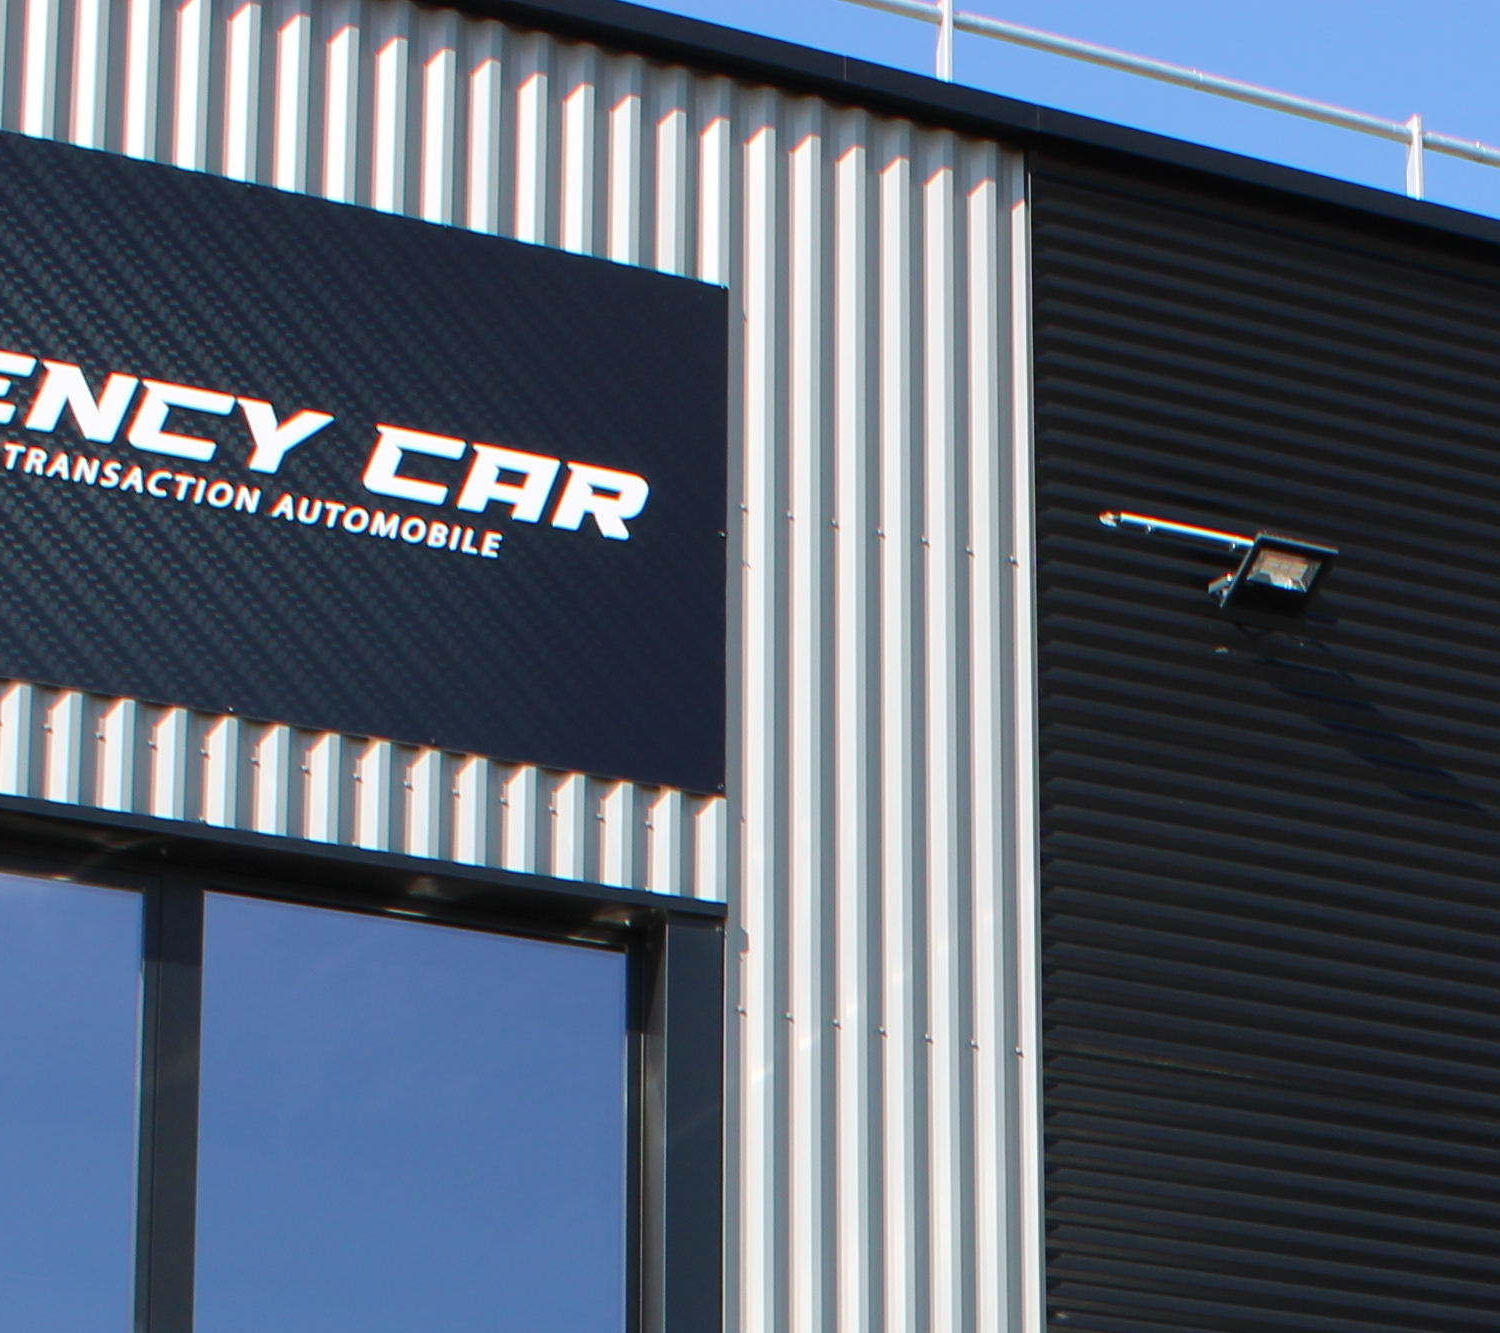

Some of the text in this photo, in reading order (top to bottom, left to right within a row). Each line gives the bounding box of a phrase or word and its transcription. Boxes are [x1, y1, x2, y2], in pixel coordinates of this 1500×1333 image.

[2, 442, 504, 559] TRANSACTION AUTOMOBILE
[362, 423, 651, 541] CAR
